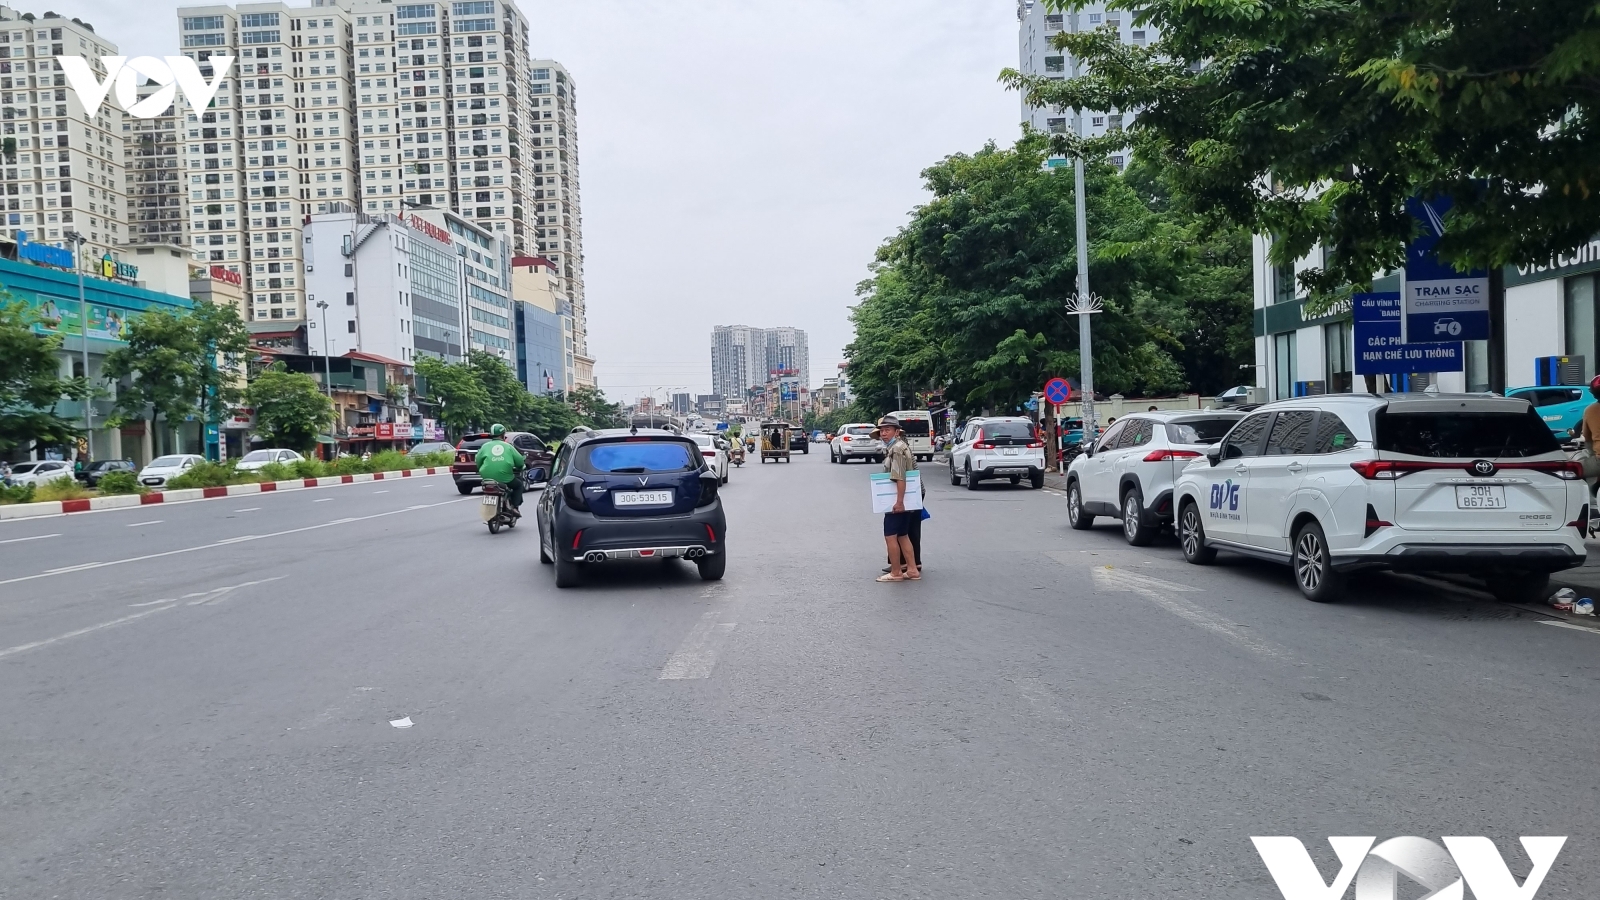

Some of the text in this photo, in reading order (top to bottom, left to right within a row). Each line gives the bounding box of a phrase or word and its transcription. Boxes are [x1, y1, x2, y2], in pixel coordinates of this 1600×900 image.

[1415, 285, 1480, 298] TRẠM SẠC
[1368, 336, 1386, 346] CÁC
[1363, 347, 1455, 362] HẠN CHẾ LƯU THÔNG
[1471, 486, 1491, 496] 30H
[1463, 497, 1500, 508] 867.51
